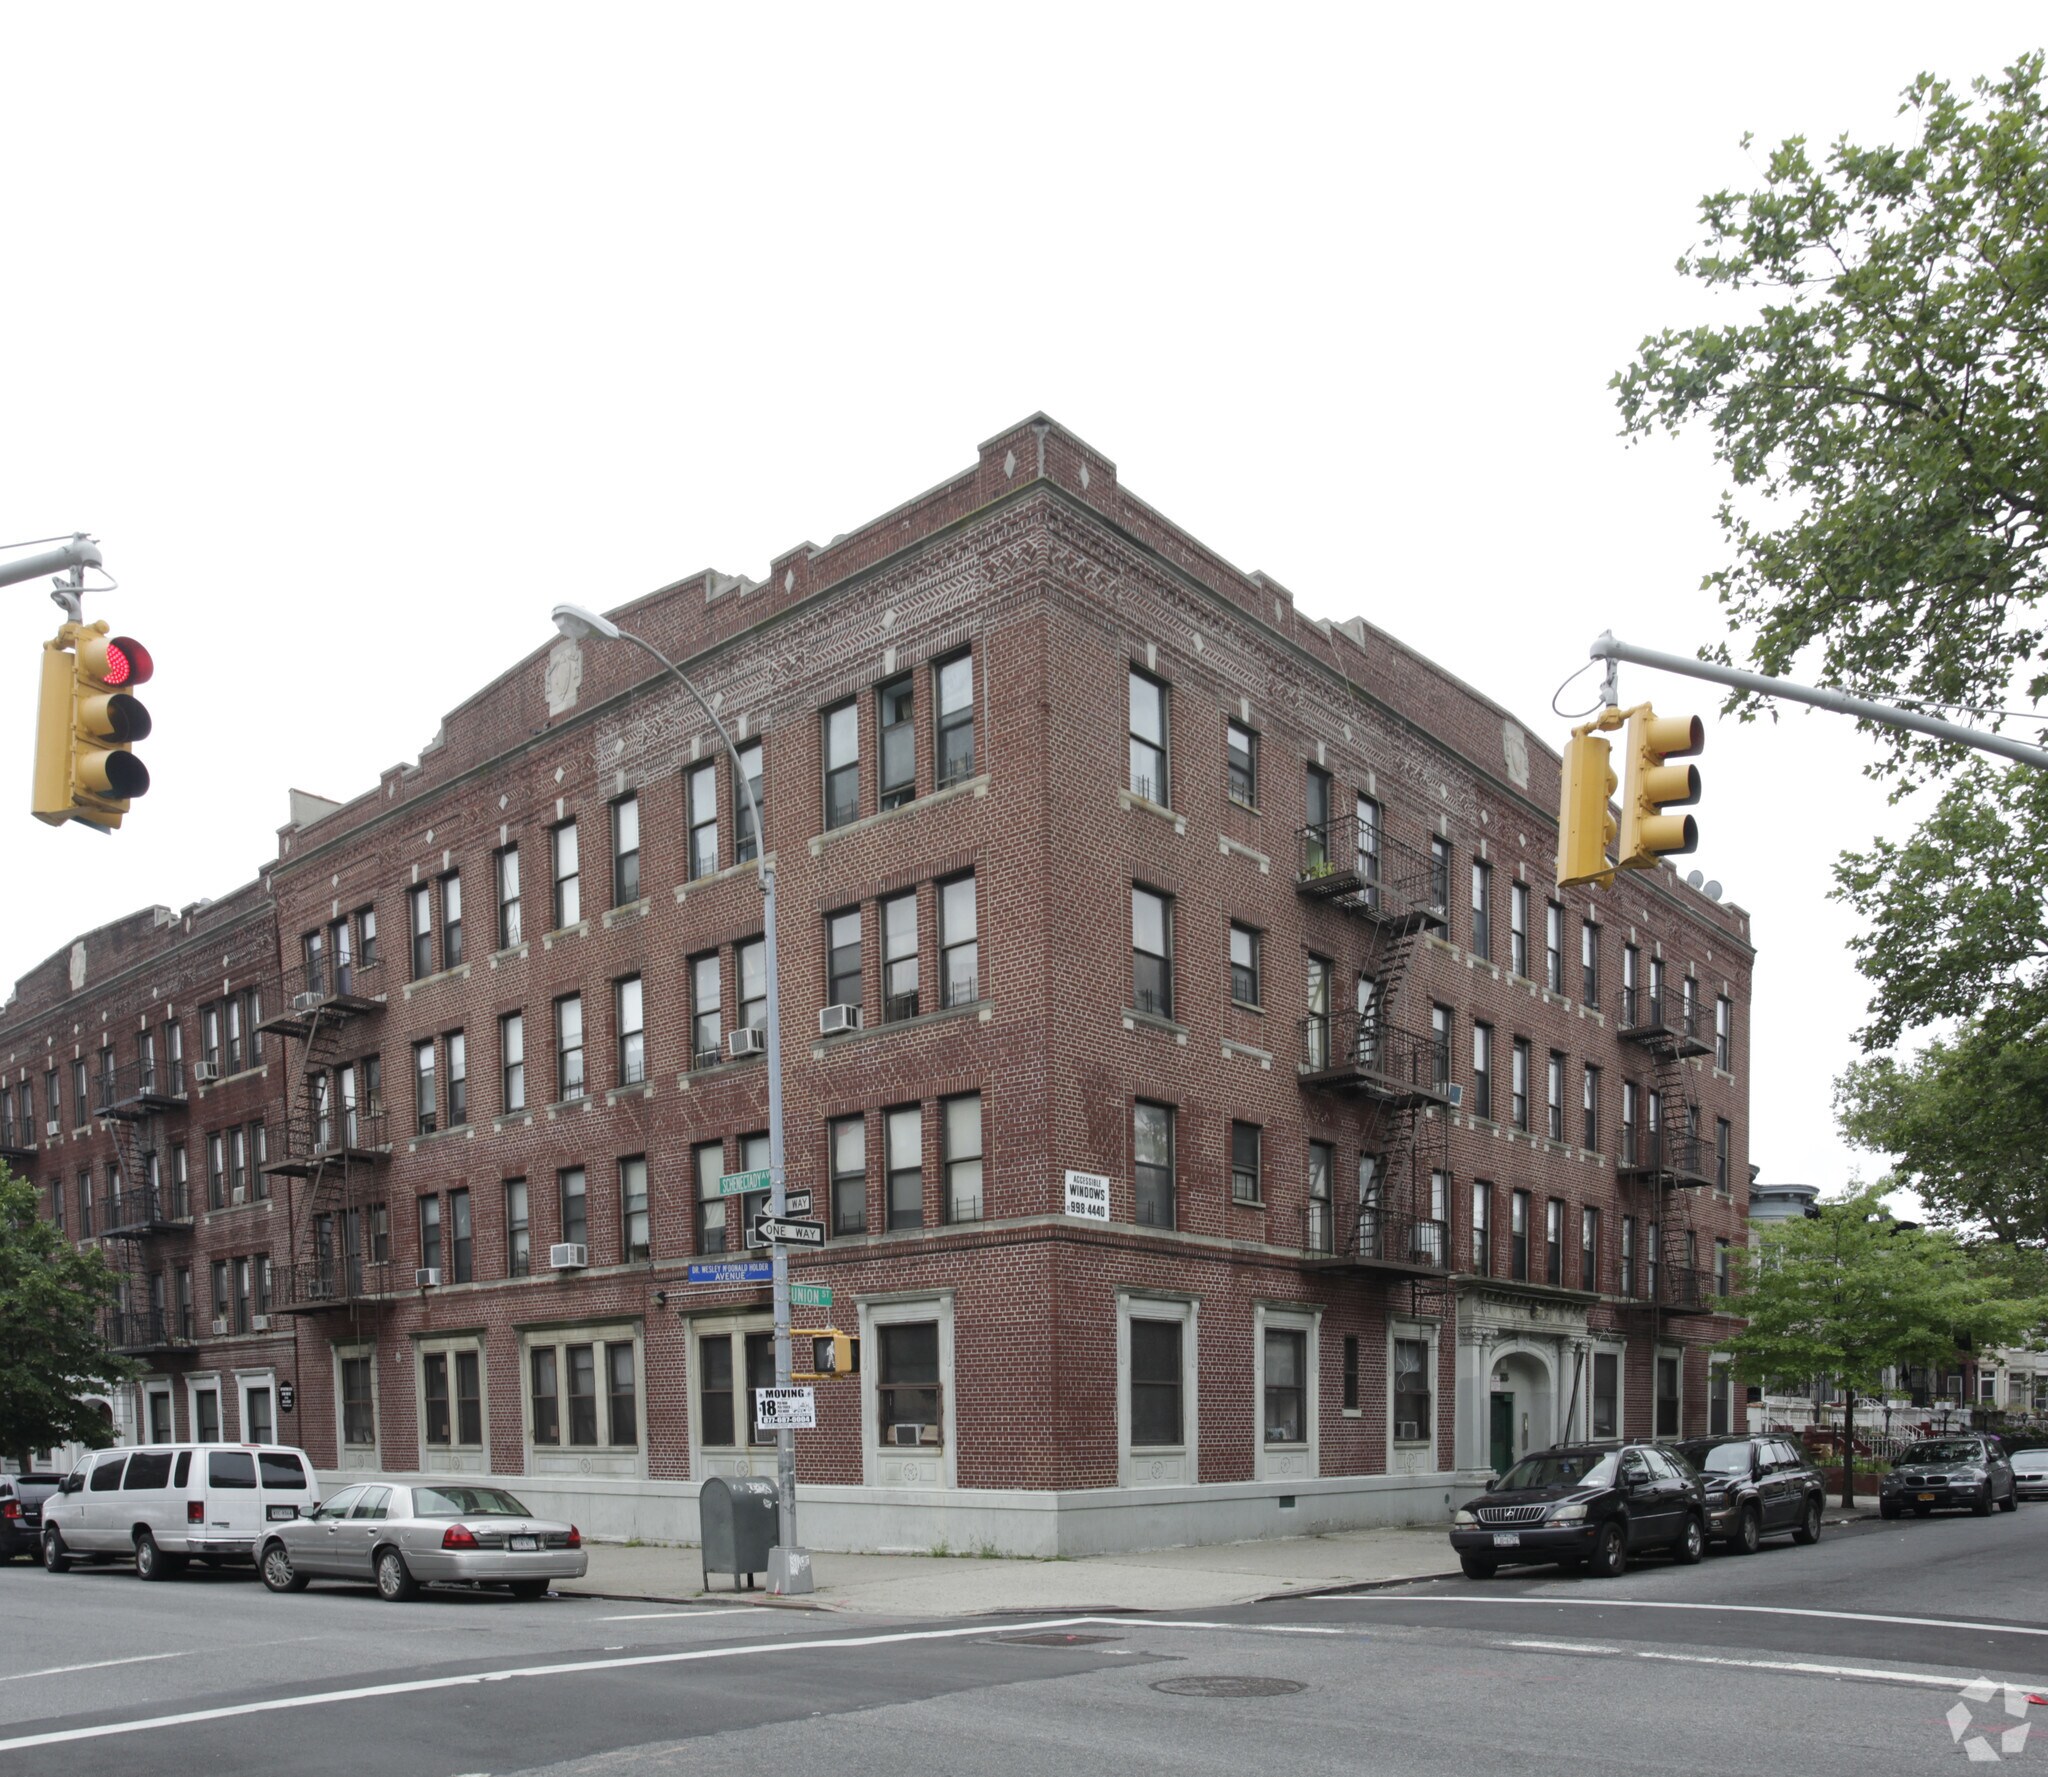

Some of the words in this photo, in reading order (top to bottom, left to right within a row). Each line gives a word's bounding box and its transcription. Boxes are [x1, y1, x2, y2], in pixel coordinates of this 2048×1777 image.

[722, 1173, 762, 1193] SCHENECTADY
[1073, 1175, 1101, 1187] ACCESSIBLE
[1069, 1184, 1105, 1201] WINDOWS
[791, 1199, 808, 1209] WAY
[765, 1224, 786, 1237] ONE
[795, 1227, 816, 1239] WAY
[701, 1264, 721, 1274] WESLEY
[748, 1262, 769, 1272] HOLDER
[715, 1271, 746, 1281] AVENUE
[791, 1286, 819, 1304] UNION
[821, 1290, 830, 1299] ST
[765, 1389, 804, 1399] MOVING
